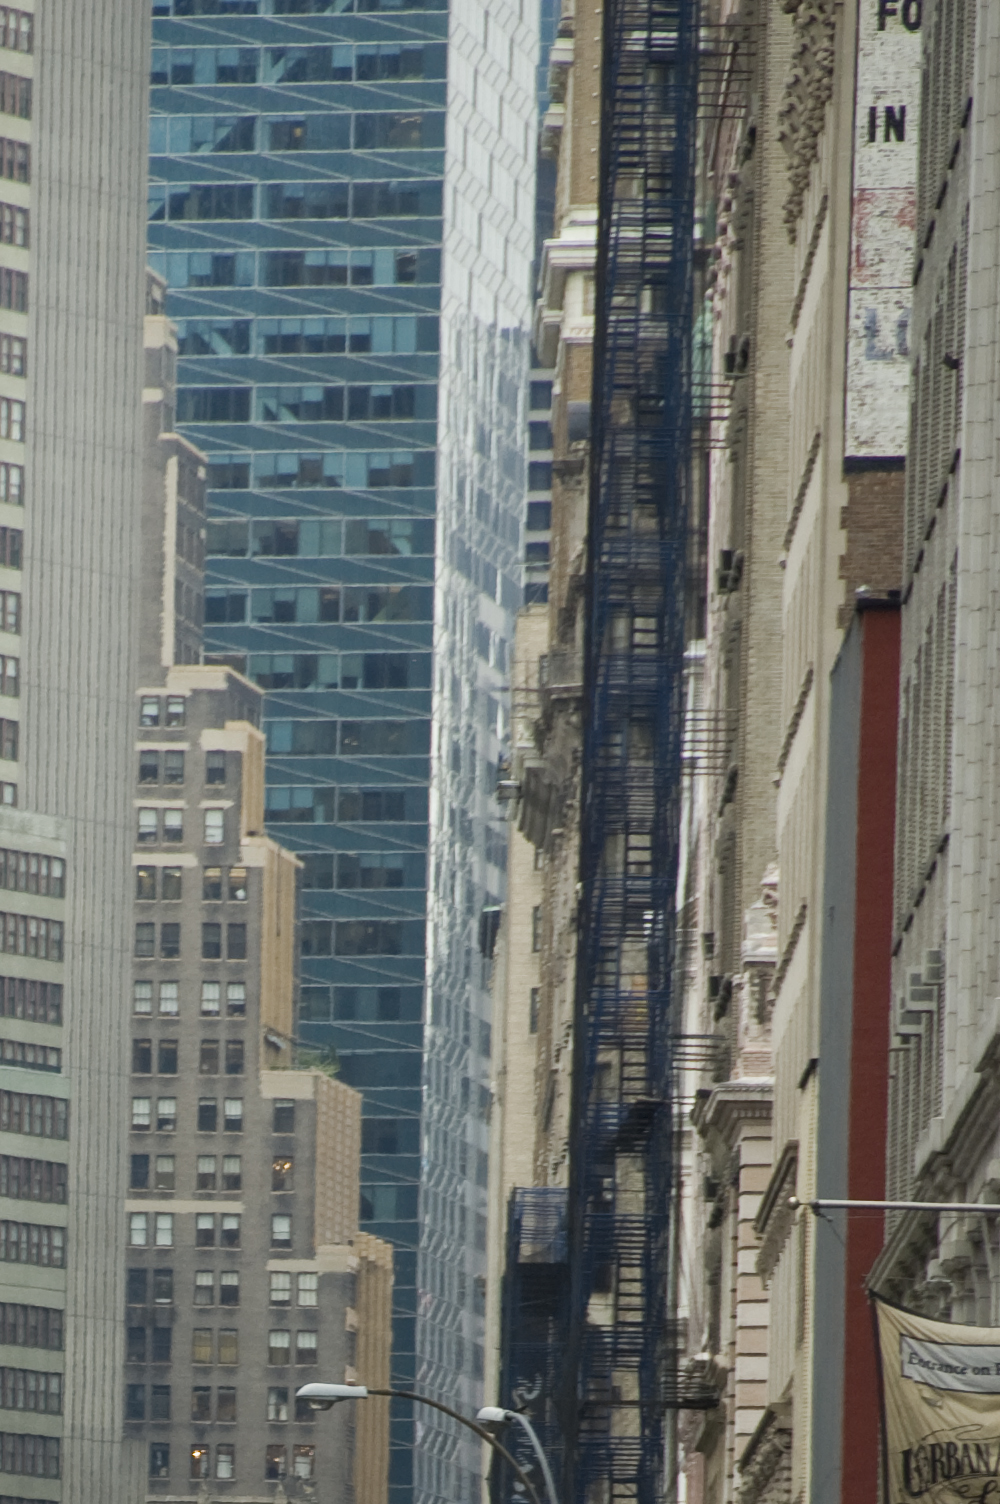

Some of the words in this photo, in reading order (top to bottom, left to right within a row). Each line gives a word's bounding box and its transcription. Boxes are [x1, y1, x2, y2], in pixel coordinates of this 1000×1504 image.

[867, 105, 907, 142] IN
[908, 1353, 967, 1375] Entrance
[973, 1366, 990, 1376] on
